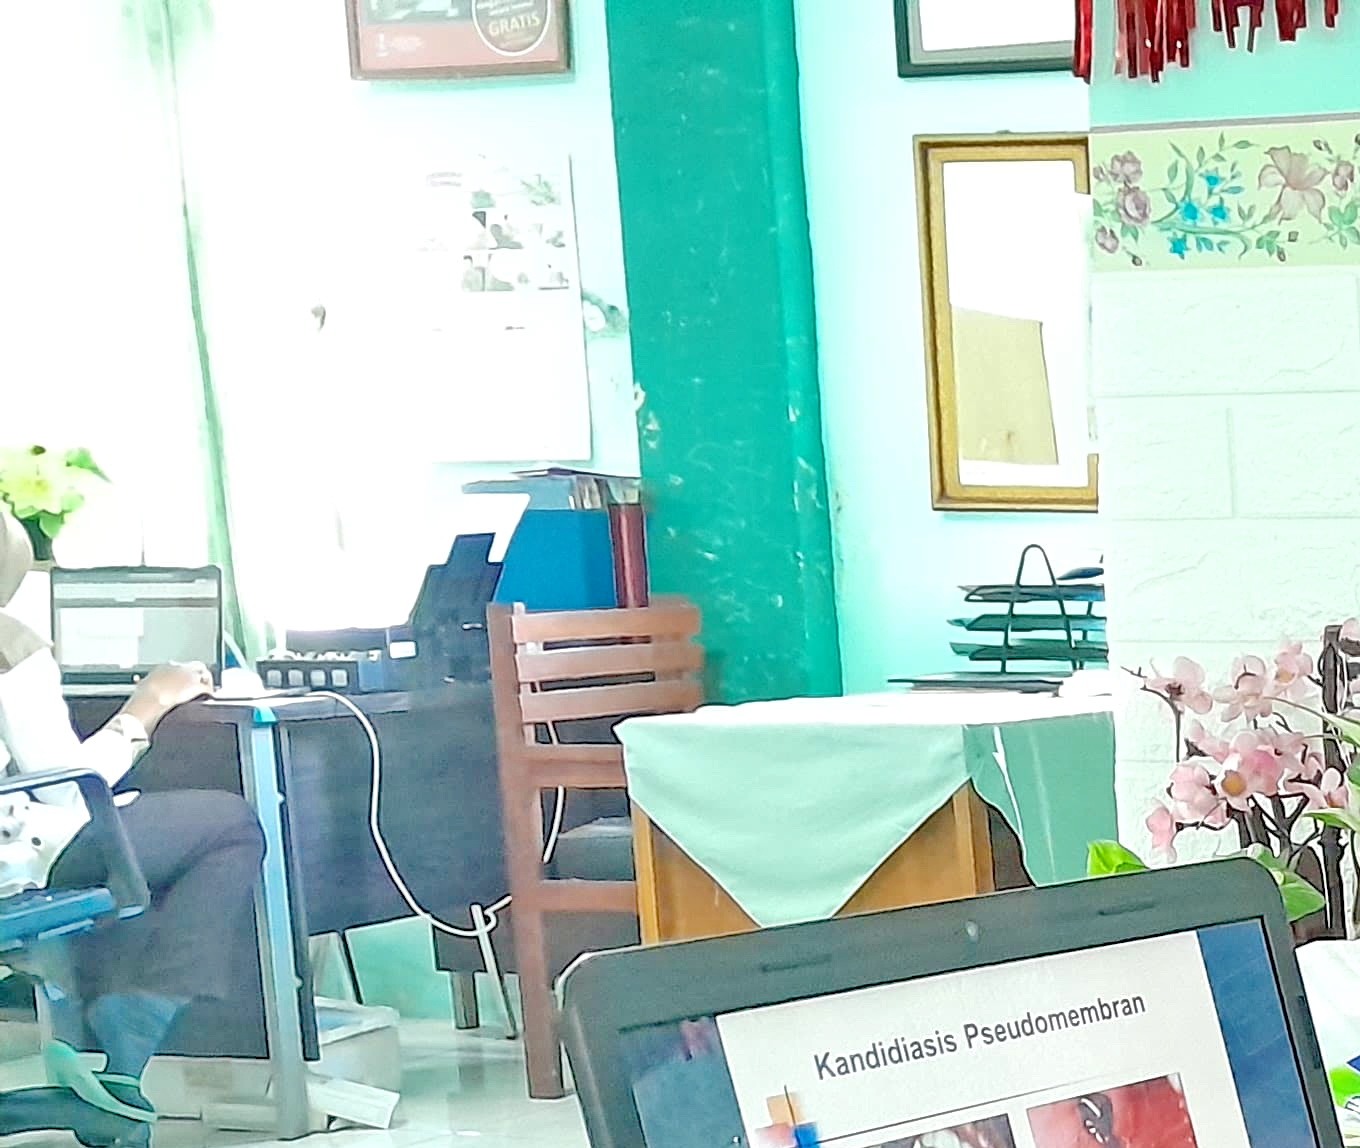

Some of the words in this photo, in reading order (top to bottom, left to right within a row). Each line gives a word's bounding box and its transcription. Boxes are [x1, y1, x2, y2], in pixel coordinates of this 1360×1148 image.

[489, 12, 540, 36] GRATIS
[813, 1030, 957, 1081] Kandidiasis
[963, 994, 1147, 1050] Pseudomembran
